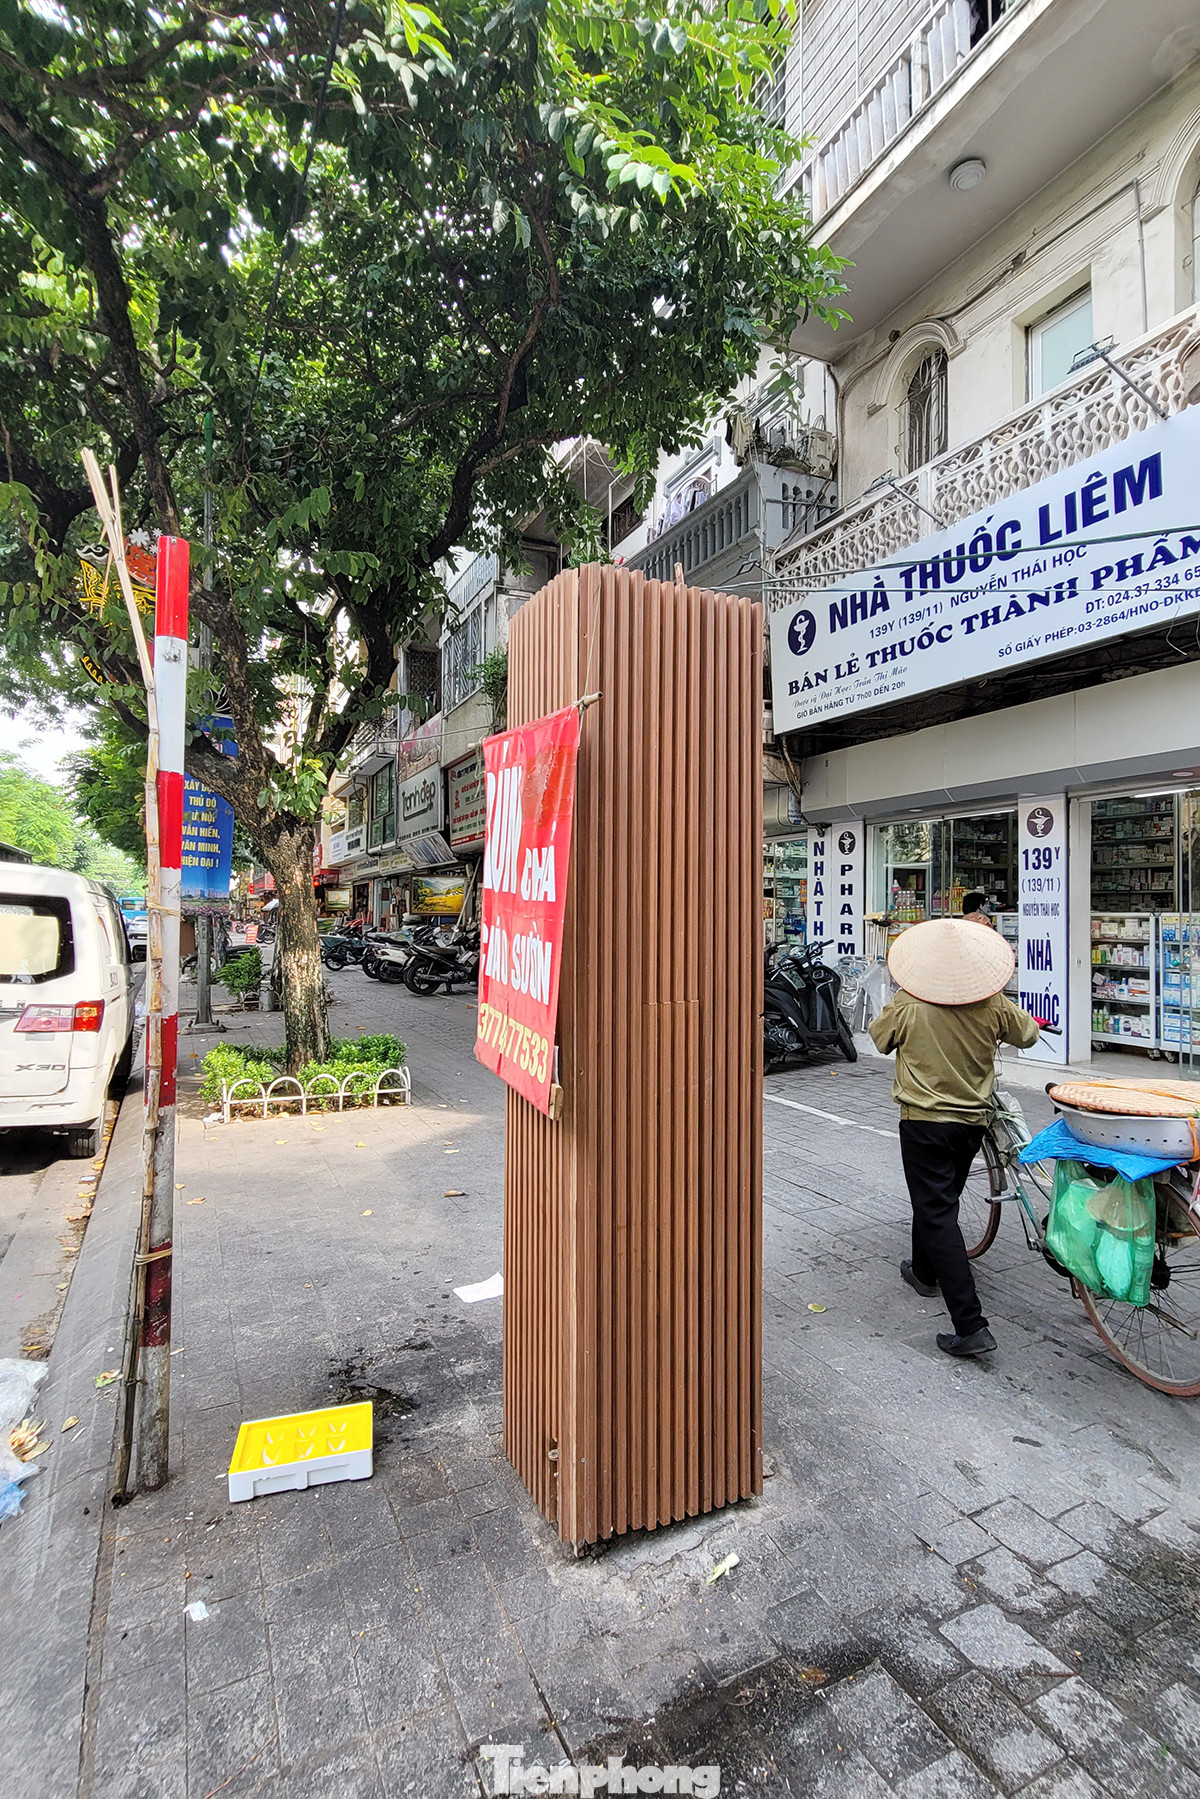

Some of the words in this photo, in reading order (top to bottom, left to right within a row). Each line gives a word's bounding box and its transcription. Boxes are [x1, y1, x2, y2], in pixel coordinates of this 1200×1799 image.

[829, 575, 891, 635] NHÀ
[899, 514, 1022, 603] THUỐC
[1038, 451, 1164, 546] LIÊM
[869, 620, 895, 640] 139Y
[898, 601, 944, 629] (139/11)
[950, 573, 1008, 608] NGUYỄN
[1011, 555, 1047, 583] THÁI
[1052, 544, 1087, 568] HỌC
[1085, 597, 1106, 615] ĐT:
[1107, 582, 1151, 608] 024.37
[1154, 572, 1181, 591] 334
[787, 670, 828, 696] BÁN
[834, 652, 861, 681] LẺ
[865, 621, 954, 669] THUỐC
[960, 576, 1080, 636] THÀNH
[998, 641, 1013, 658] SỐ
[1014, 632, 1042, 652] GIẤY
[891, 680, 906, 691] 20h
[184, 779, 200, 791] XÂY
[189, 794, 204, 807] THỦ
[520, 820, 557, 903] CHẢ
[837, 864, 856, 956] PHARM
[511, 921, 553, 1006] SƯỜN
[1026, 932, 1053, 972] NHÀ
[1019, 981, 1060, 1027] THUỐC
[14, 1063, 66, 1072] X30
